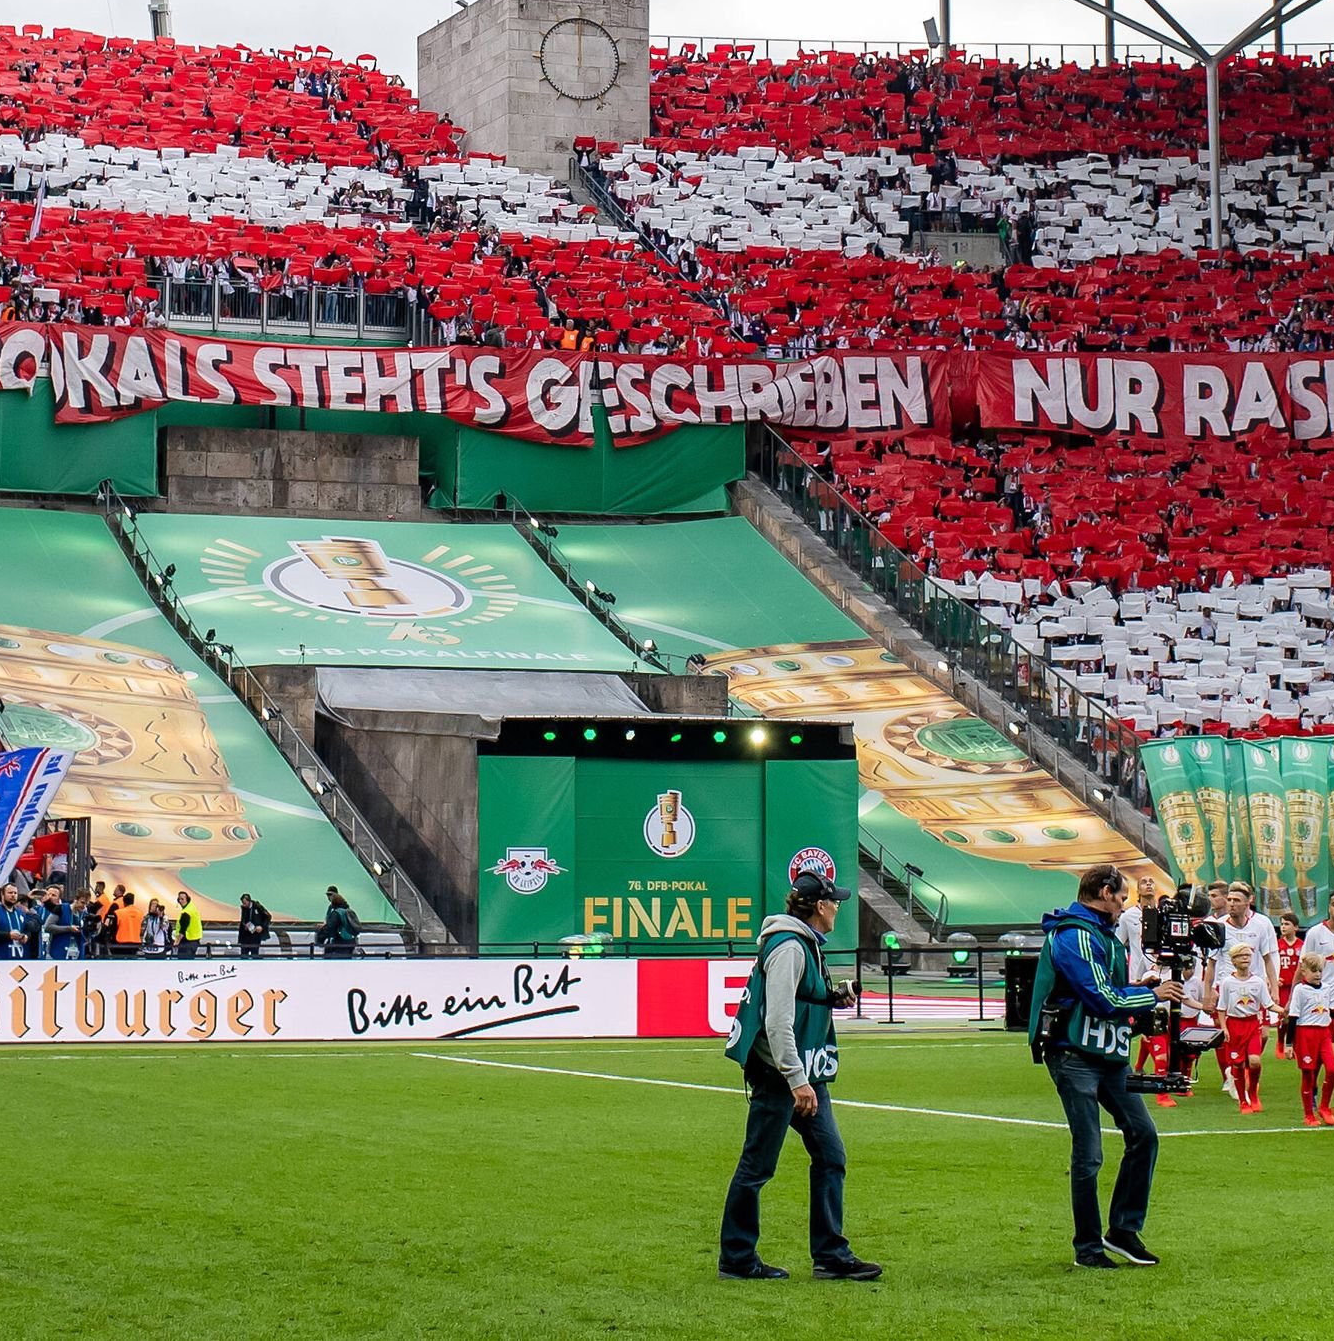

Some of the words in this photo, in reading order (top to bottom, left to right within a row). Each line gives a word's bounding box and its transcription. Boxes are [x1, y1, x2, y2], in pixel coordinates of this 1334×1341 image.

[253, 346, 508, 426] STEHT'S
[1012, 357, 1159, 435] NUR
[801, 849, 833, 869] BAYERN
[584, 897, 752, 938] FINALE
[347, 987, 433, 1035] Bitte
[442, 986, 507, 1016] ein
[513, 964, 582, 1005] Bit
